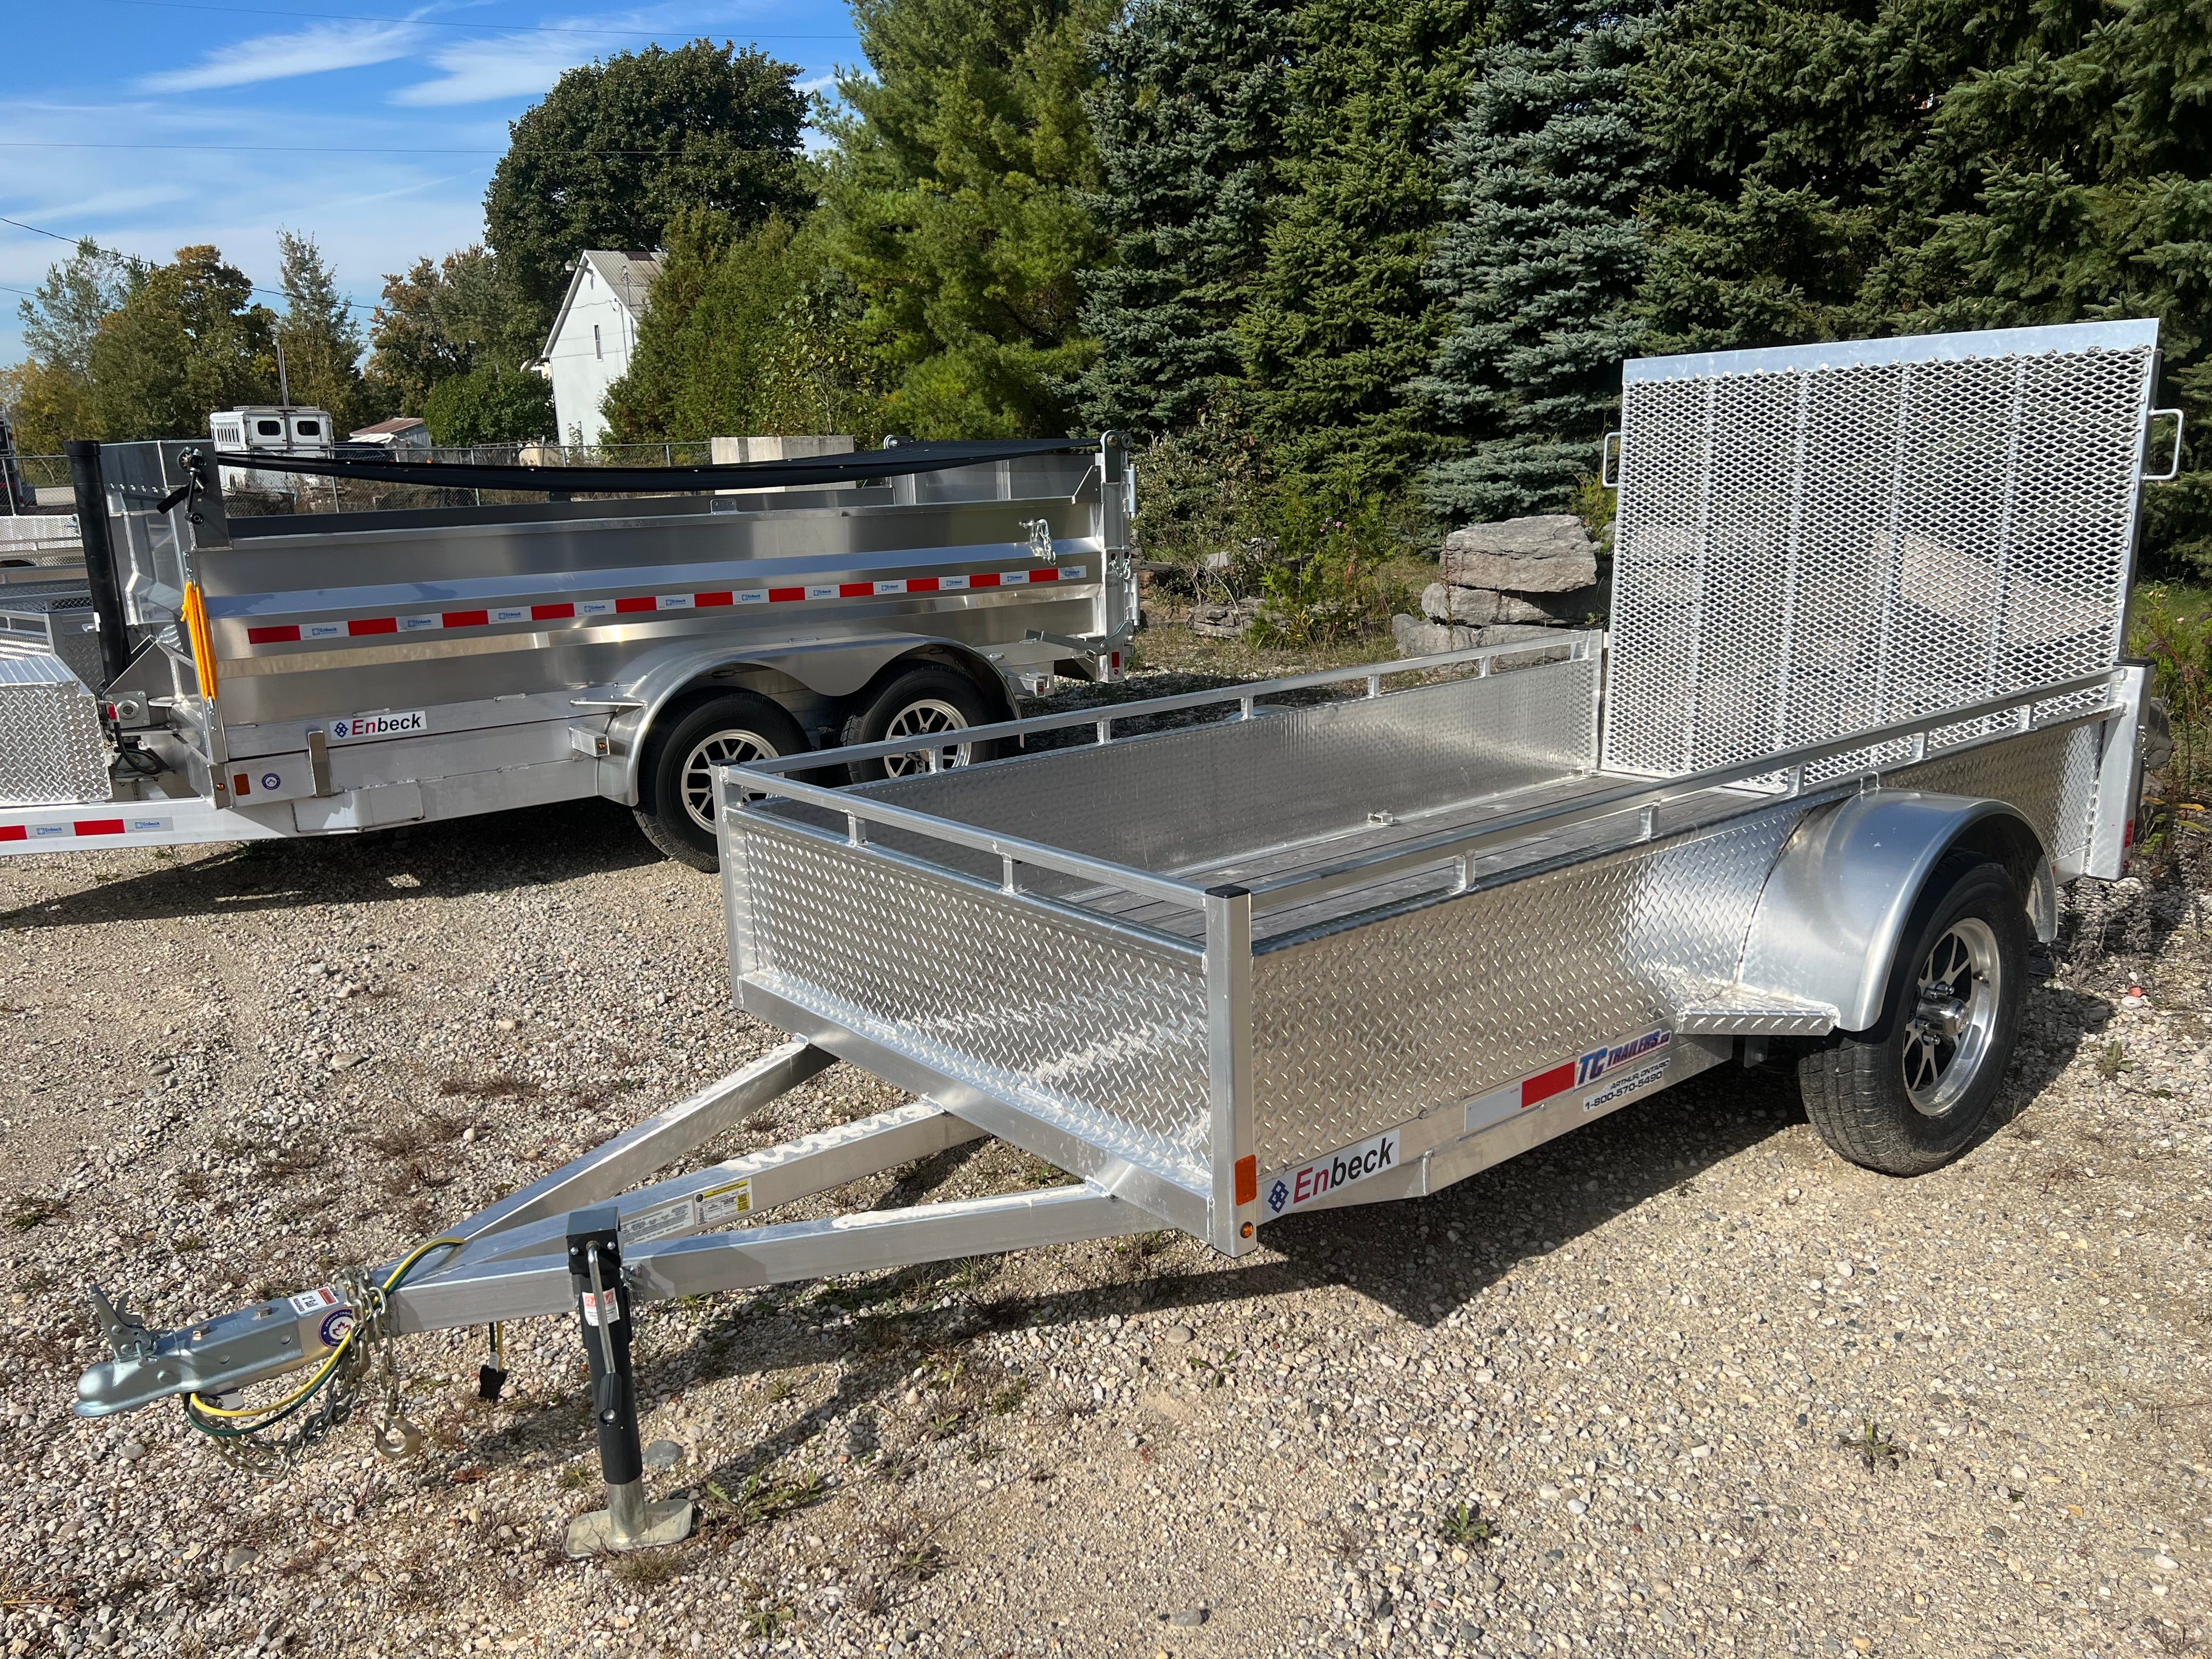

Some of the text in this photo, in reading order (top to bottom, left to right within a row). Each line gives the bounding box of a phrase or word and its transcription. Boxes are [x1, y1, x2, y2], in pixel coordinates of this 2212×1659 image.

[352, 713, 421, 735] Enbeck
[1578, 1047, 1608, 1085] TC
[1640, 1060, 1669, 1077] ONTARIO
[1585, 1071, 1662, 1110] 1-800-570-5490
[1293, 1137, 1394, 1204] Enbeck
